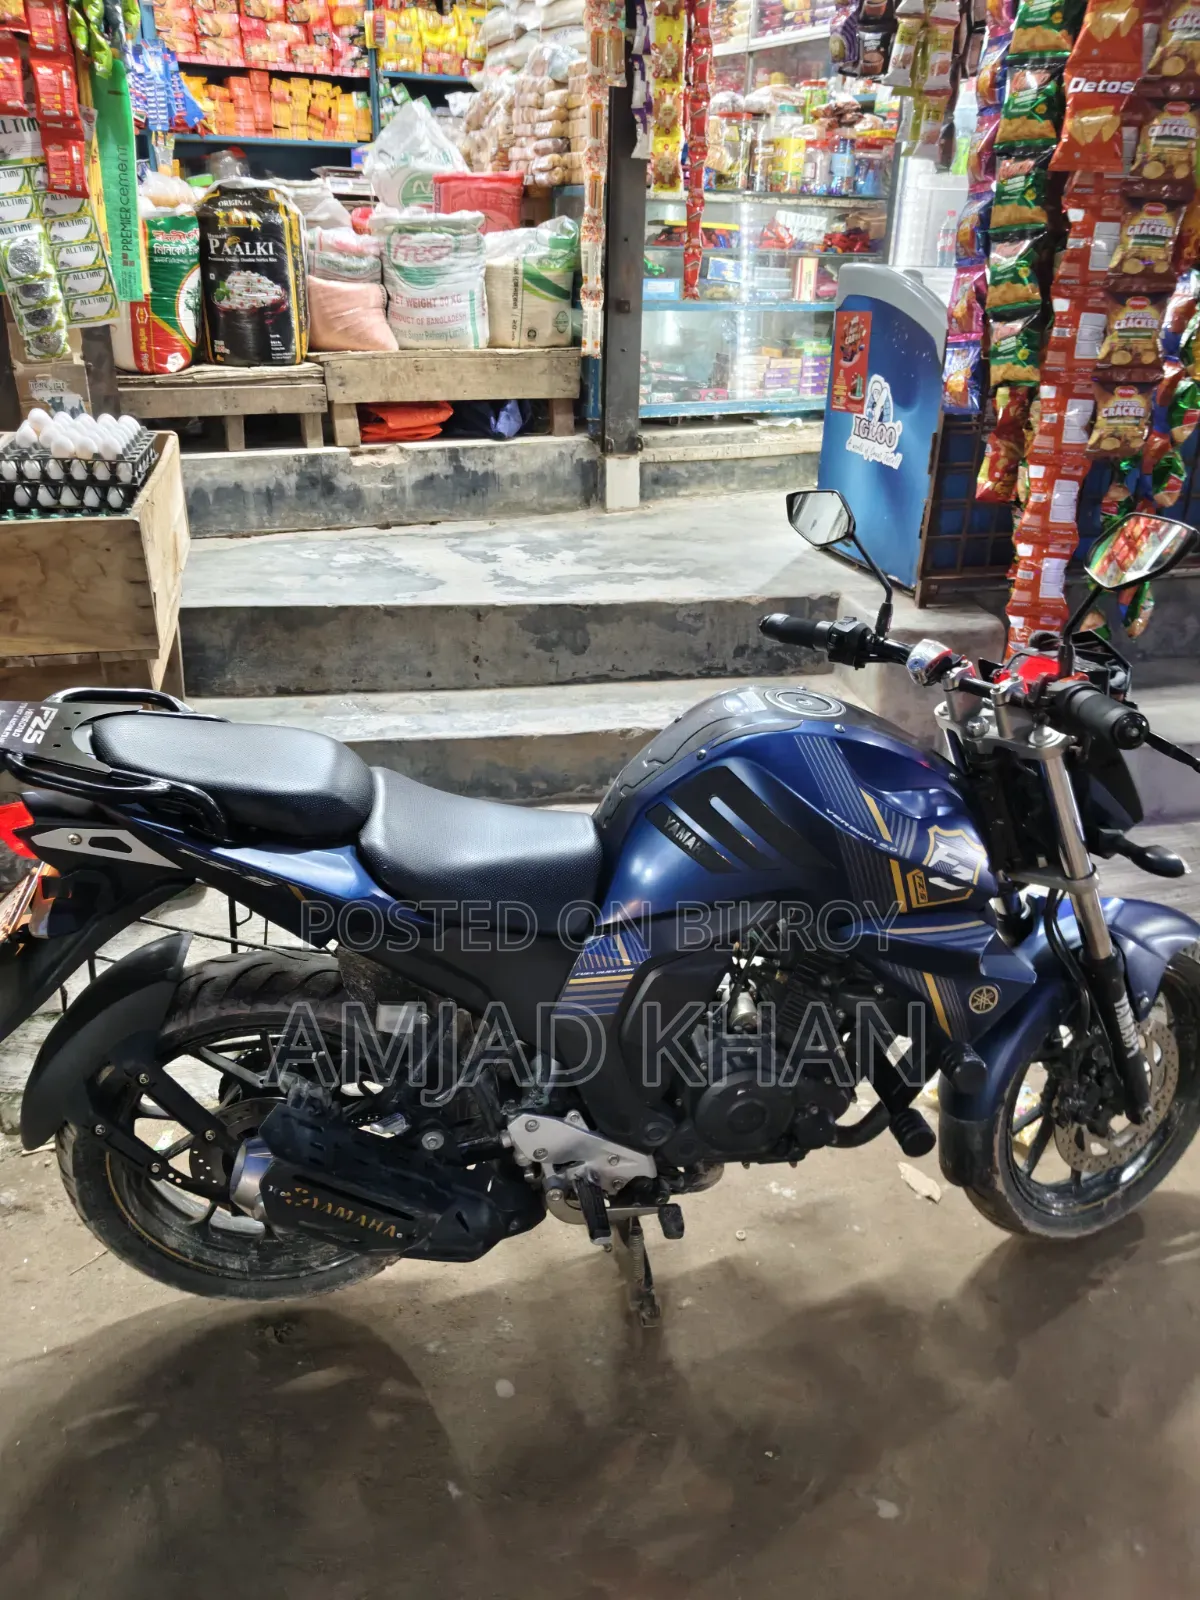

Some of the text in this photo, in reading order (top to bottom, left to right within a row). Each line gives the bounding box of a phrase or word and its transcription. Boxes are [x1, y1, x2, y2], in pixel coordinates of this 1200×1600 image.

[1068, 77, 1134, 94] Detos
[117, 145, 130, 206] cement
[120, 206, 133, 252] PREMIER
[1127, 224, 1173, 236] CRACKER
[208, 238, 274, 255] PAALKI
[405, 296, 437, 309] WEIGHT
[426, 312, 467, 326] BANGLADESH
[1114, 318, 1160, 330] CRACKER
[853, 416, 897, 448] IGLOO
[22, 706, 58, 744] FZS
